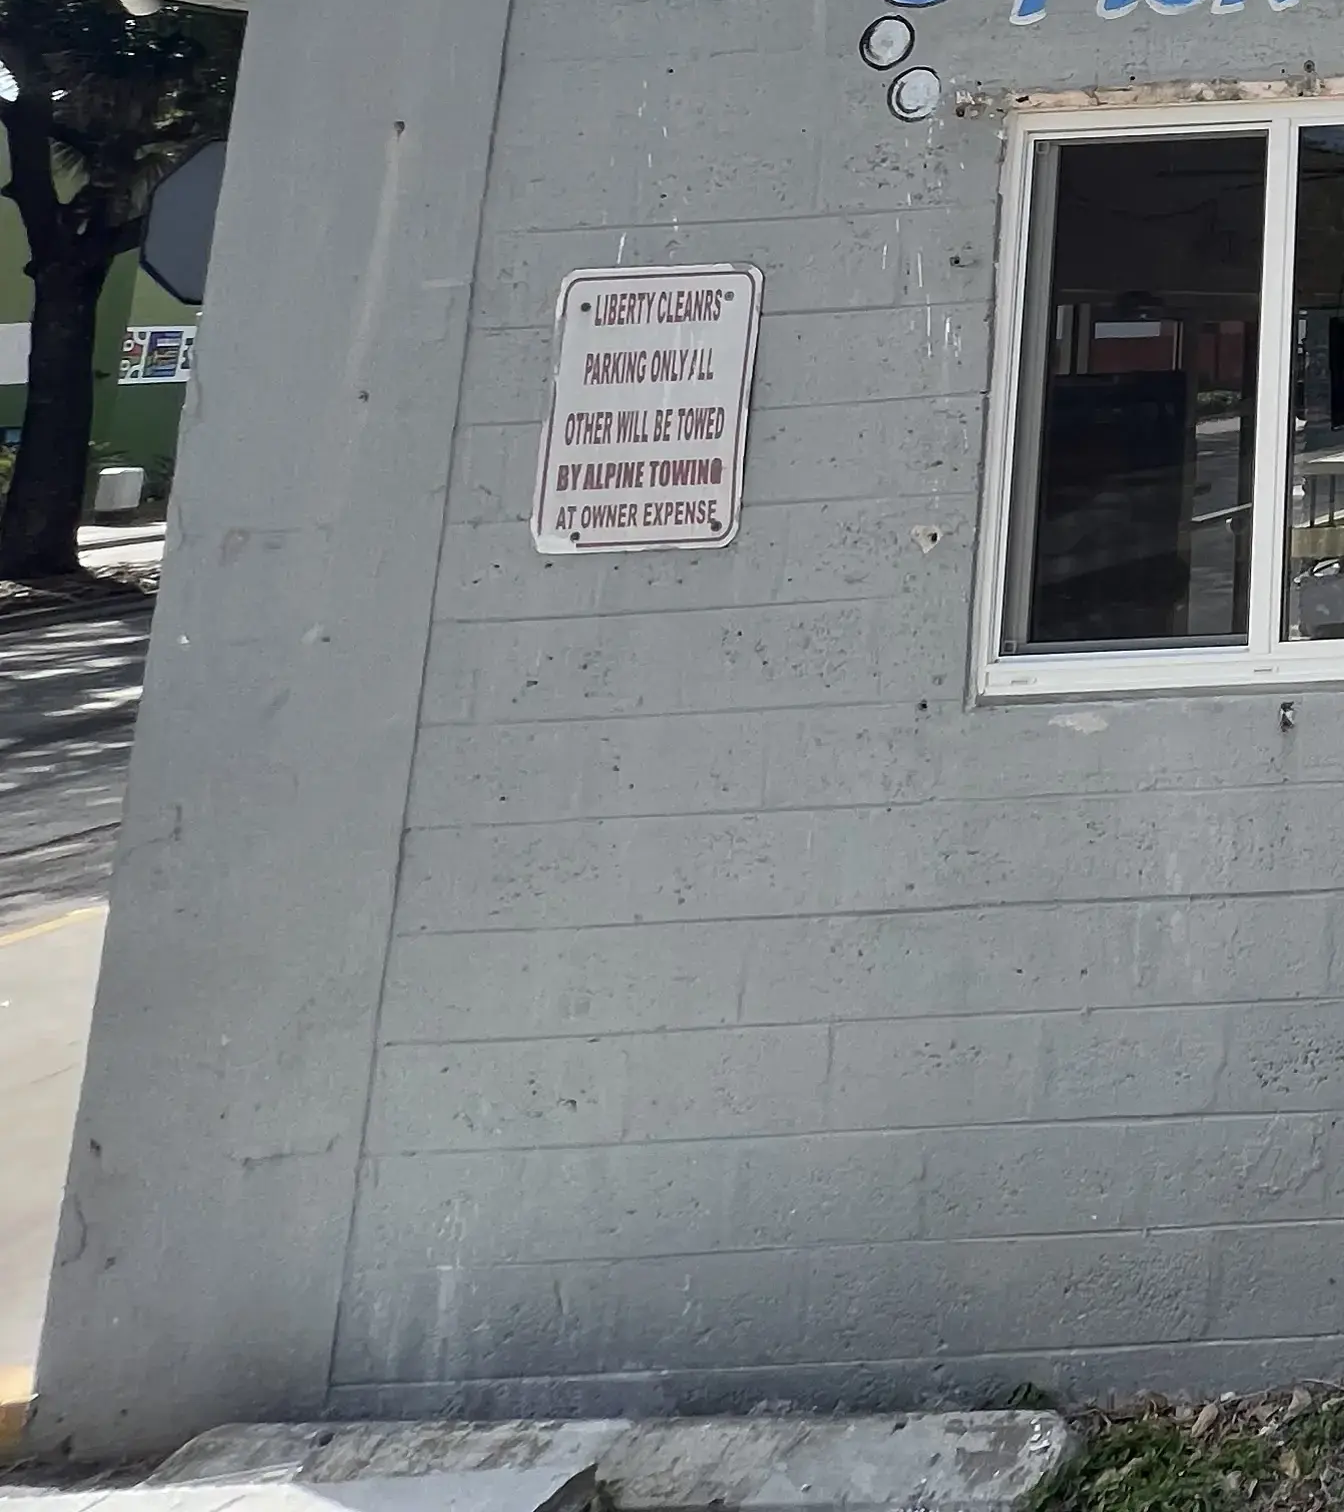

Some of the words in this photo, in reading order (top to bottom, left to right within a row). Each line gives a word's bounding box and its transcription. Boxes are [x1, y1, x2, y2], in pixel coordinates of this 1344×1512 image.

[594, 291, 656, 326] LIBERTY
[657, 289, 723, 324] CLEANRS
[583, 350, 647, 385] PARKING
[650, 349, 688, 383] ONLY
[565, 412, 612, 446] OTHER
[616, 410, 648, 444] WILL
[652, 409, 671, 442] BE
[677, 407, 725, 440] TOWED
[556, 463, 583, 491] BY
[582, 461, 645, 490] ALPINE
[555, 506, 577, 530] AT
[580, 503, 638, 529] OWNER
[643, 500, 717, 526] EXPENSE
